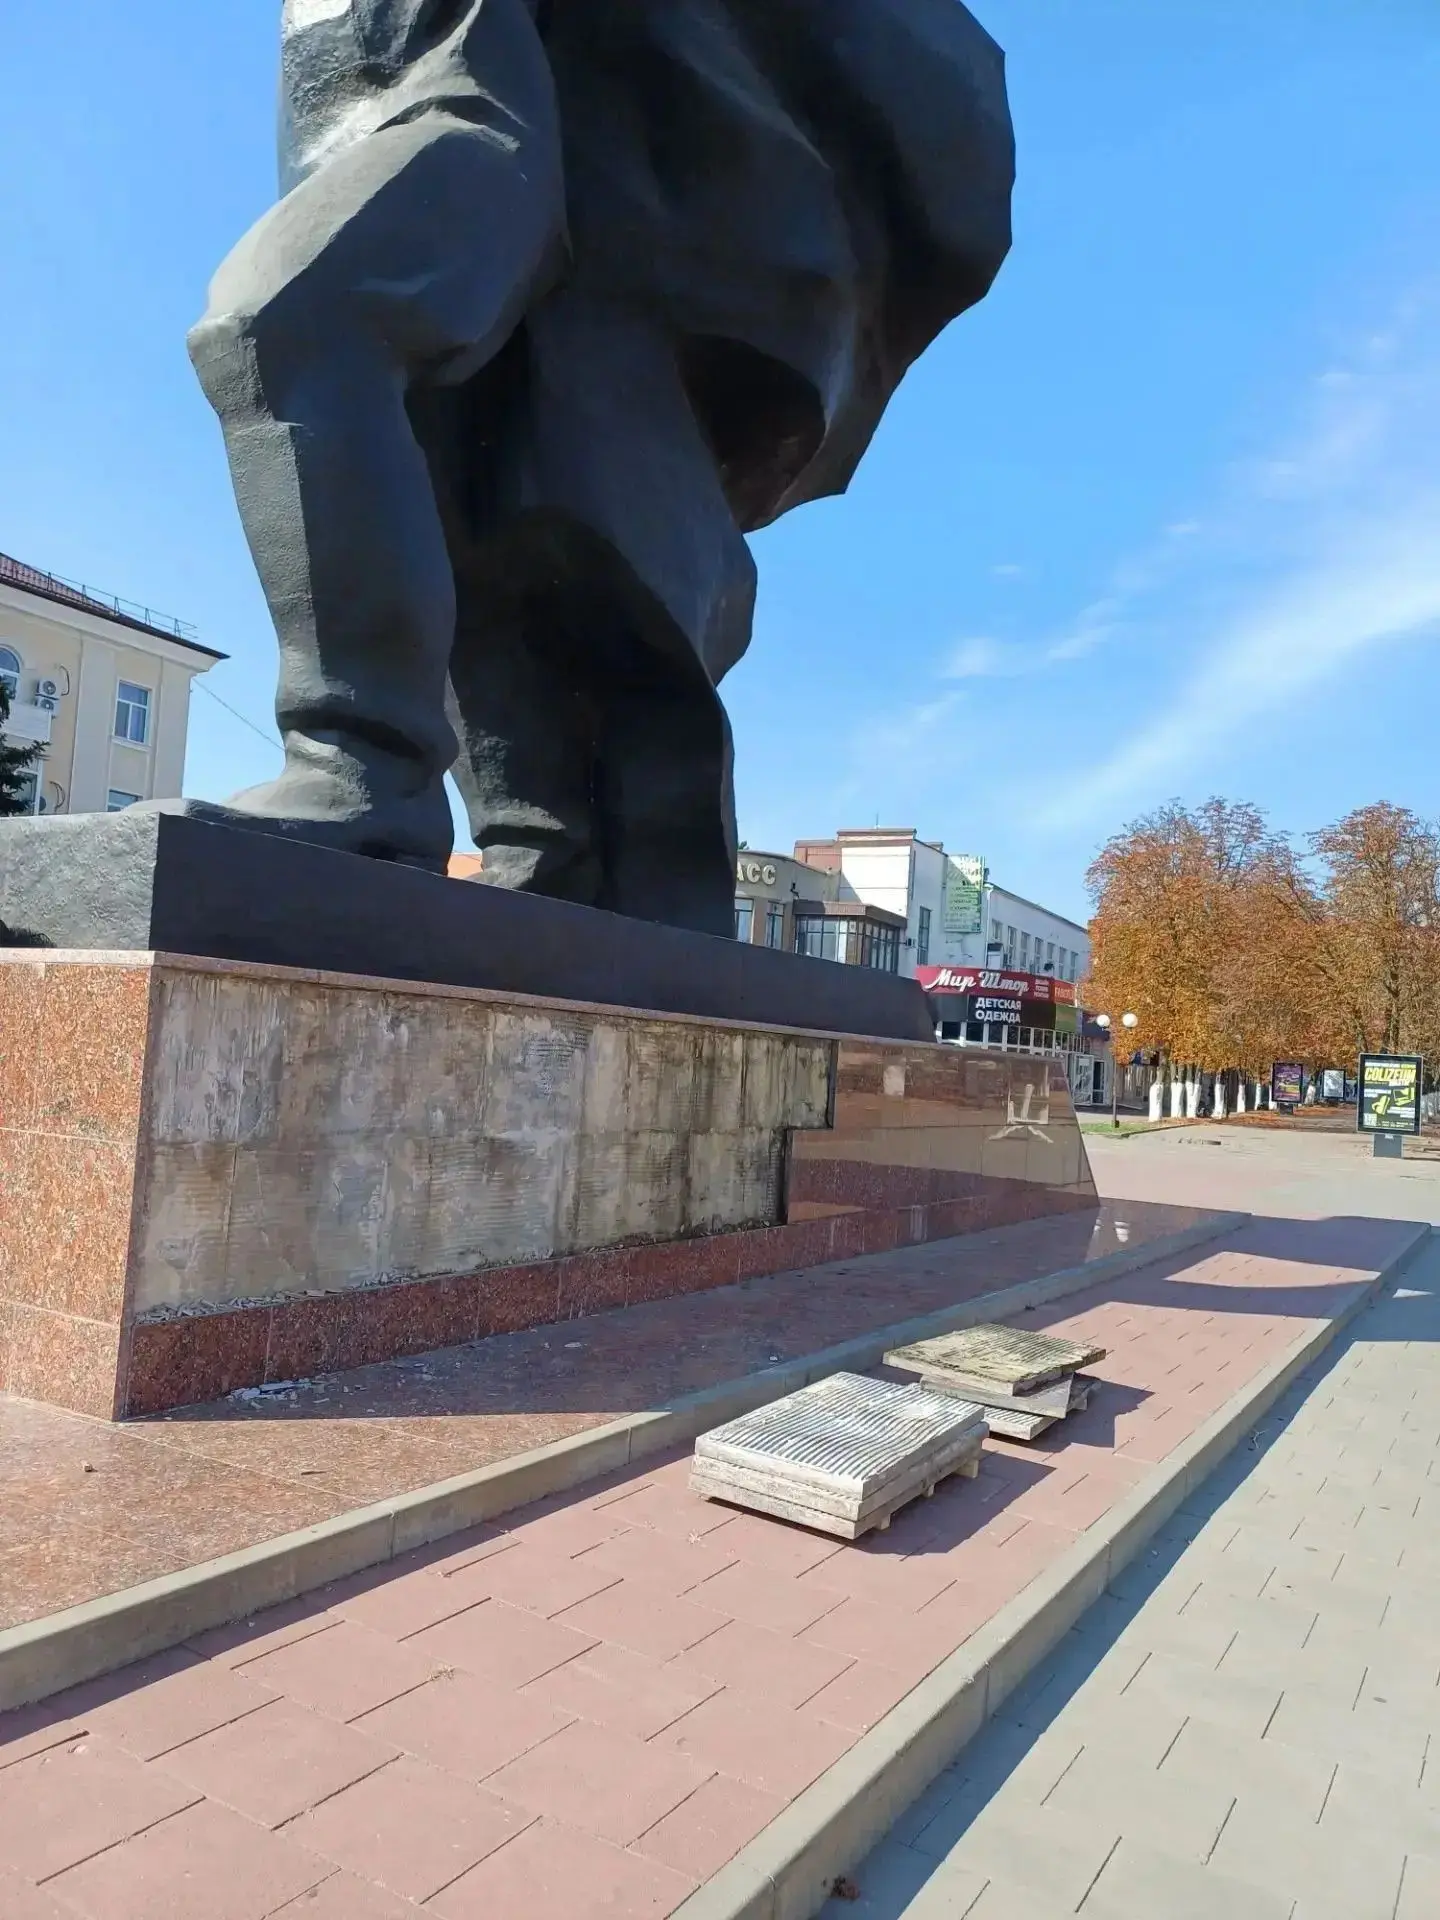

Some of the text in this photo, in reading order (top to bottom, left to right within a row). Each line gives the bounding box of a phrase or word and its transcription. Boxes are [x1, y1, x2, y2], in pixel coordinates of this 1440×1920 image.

[924, 968, 976, 992] Мир
[979, 971, 1029, 996] Штор
[975, 997, 1021, 1011] ДЕТСКАЯ
[975, 1009, 1020, 1023] ОДЕЖДА
[1365, 1067, 1416, 1084] COLIZEUM
